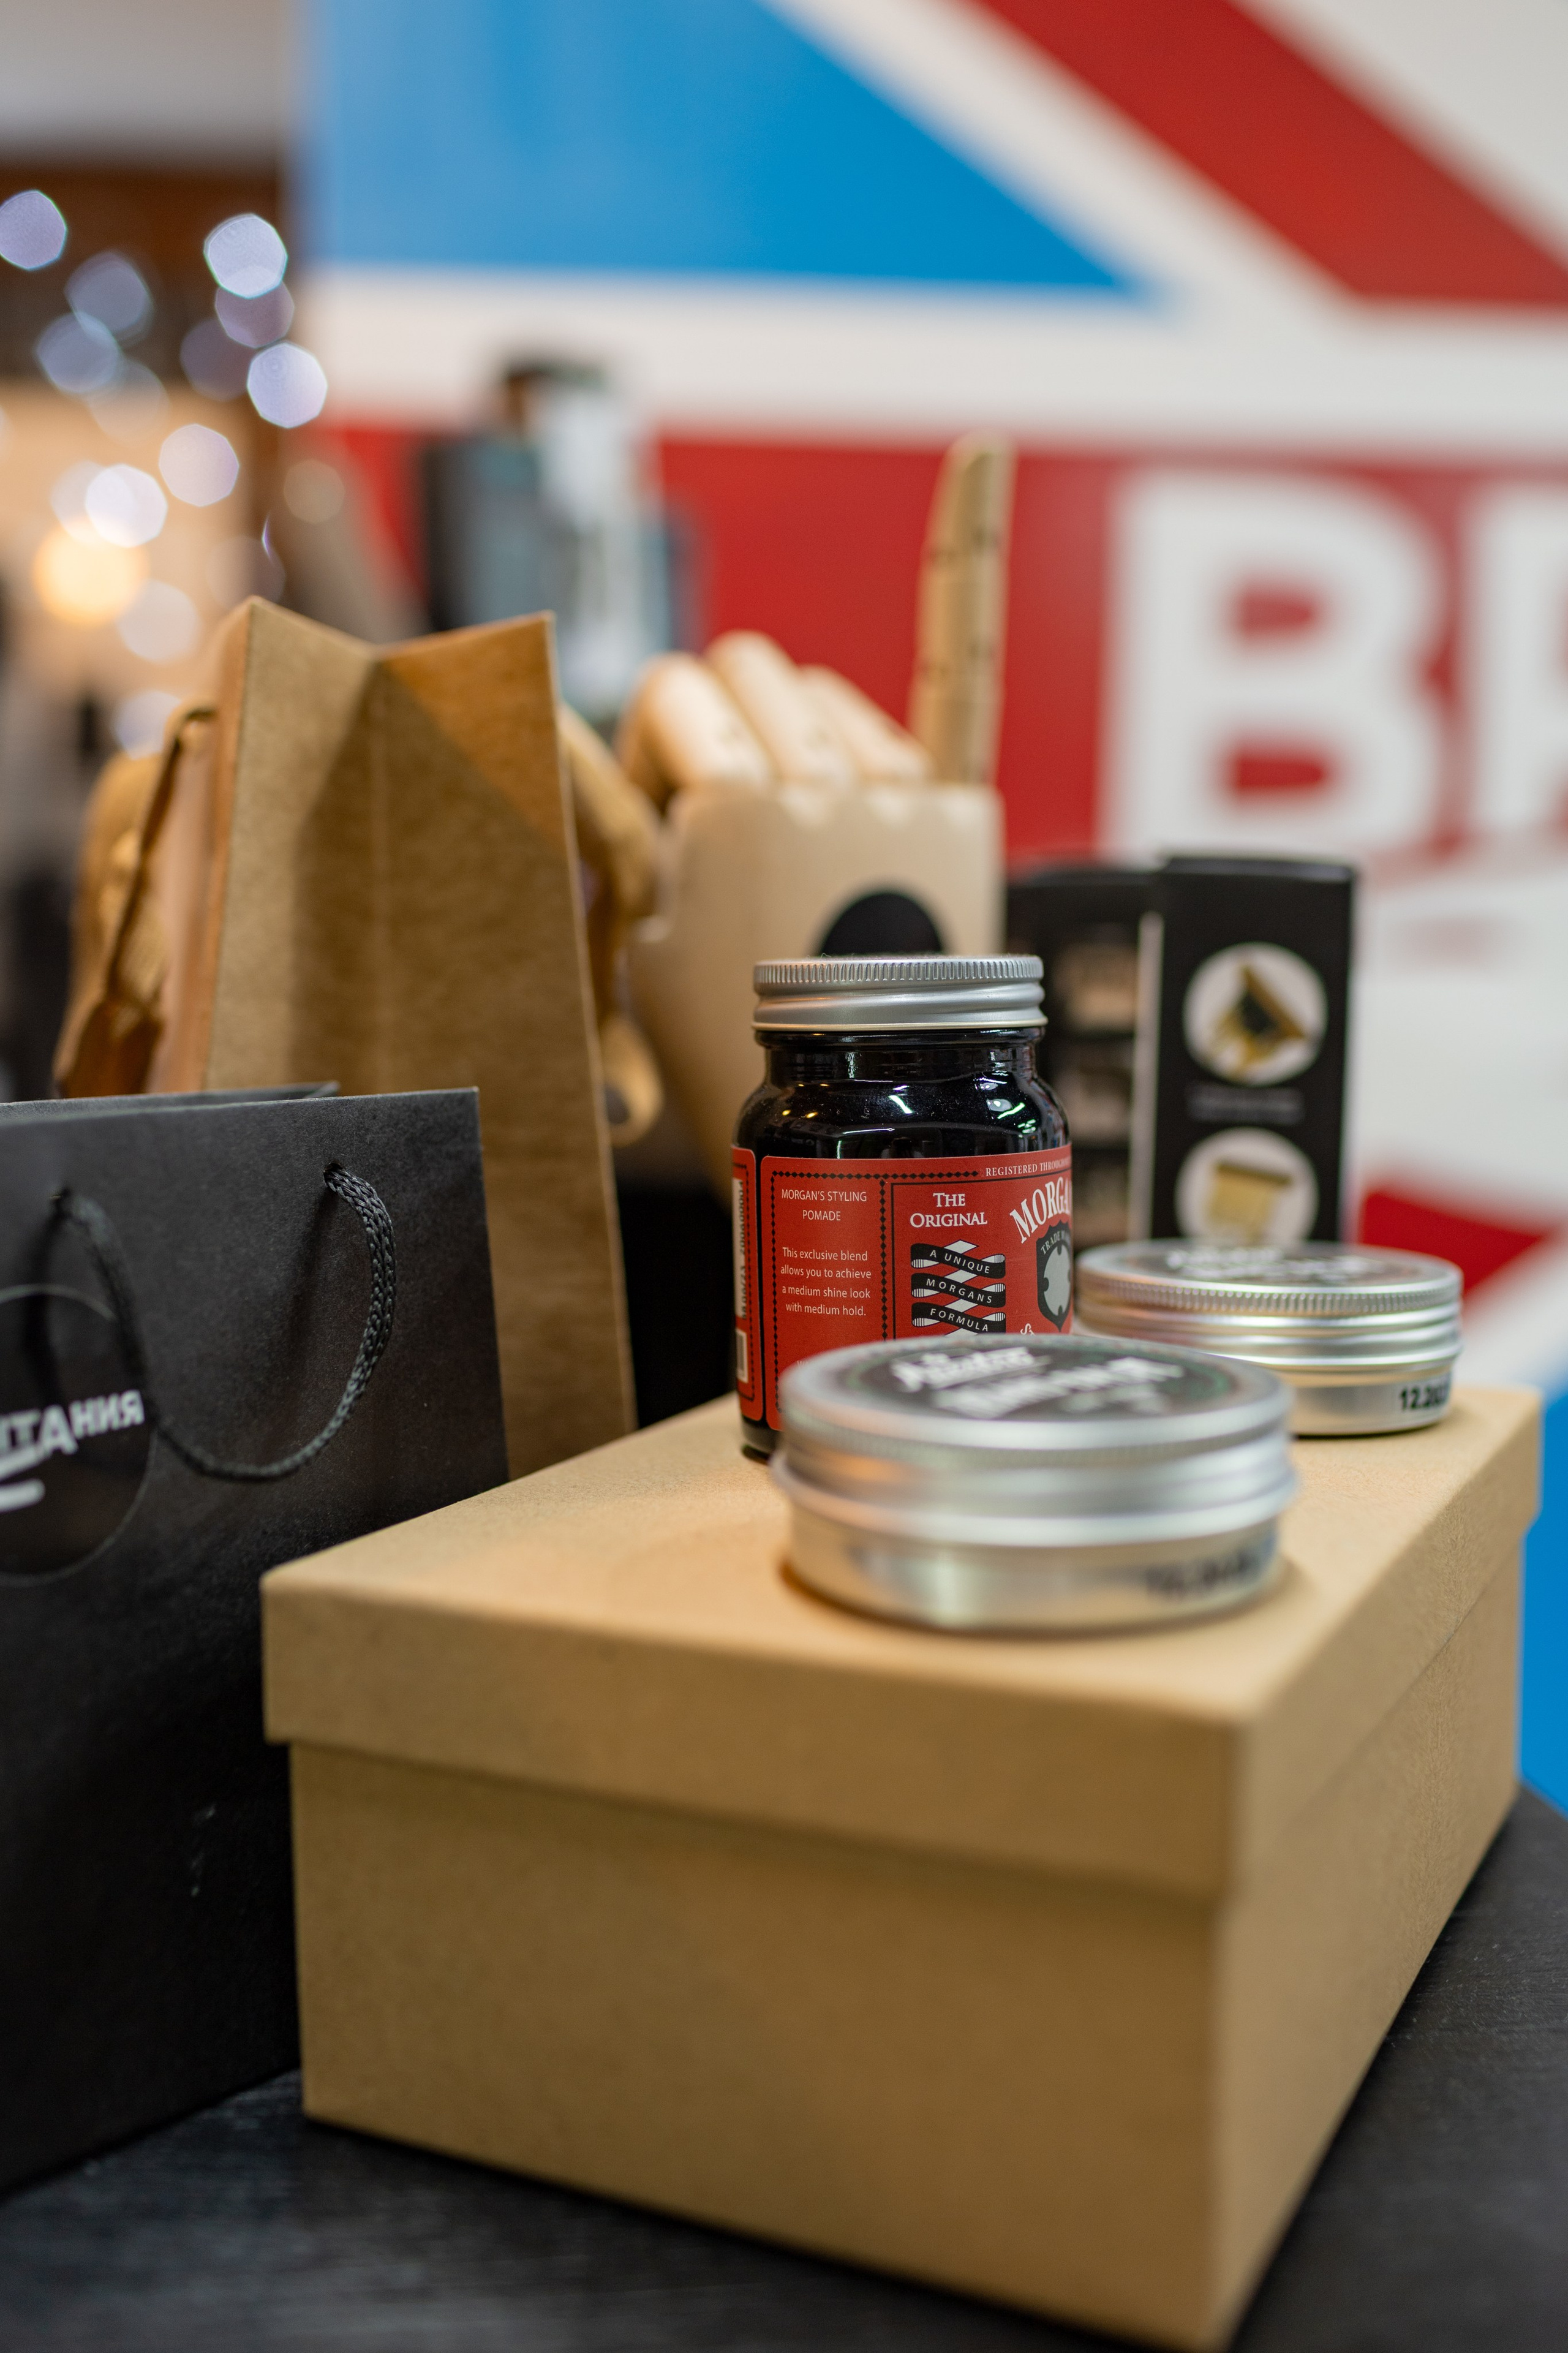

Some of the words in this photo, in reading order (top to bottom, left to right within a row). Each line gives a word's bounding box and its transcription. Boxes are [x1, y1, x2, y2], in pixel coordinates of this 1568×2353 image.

[986, 1164, 1038, 1177] REGISTERED
[782, 1189, 825, 1201] MORGAN'S
[827, 1192, 867, 1202] STYLING
[802, 1210, 841, 1221] POMADE
[1009, 1176, 1072, 1244] MORGA
[782, 1247, 797, 1258] This
[799, 1249, 839, 1260] exclusive
[840, 1250, 868, 1261] blend
[944, 1253, 990, 1274] UNIQUE
[780, 1264, 804, 1276] allows
[806, 1269, 821, 1278] you
[824, 1268, 833, 1278] to
[835, 1268, 872, 1278] achieve
[788, 1285, 821, 1297] medium
[823, 1287, 847, 1298] shine
[850, 1288, 871, 1299] look
[926, 1278, 992, 1304] MORGANS
[786, 1302, 802, 1313] with
[804, 1304, 840, 1315] medium
[843, 1305, 866, 1316] hold.
[930, 1309, 989, 1332] FORMULA
